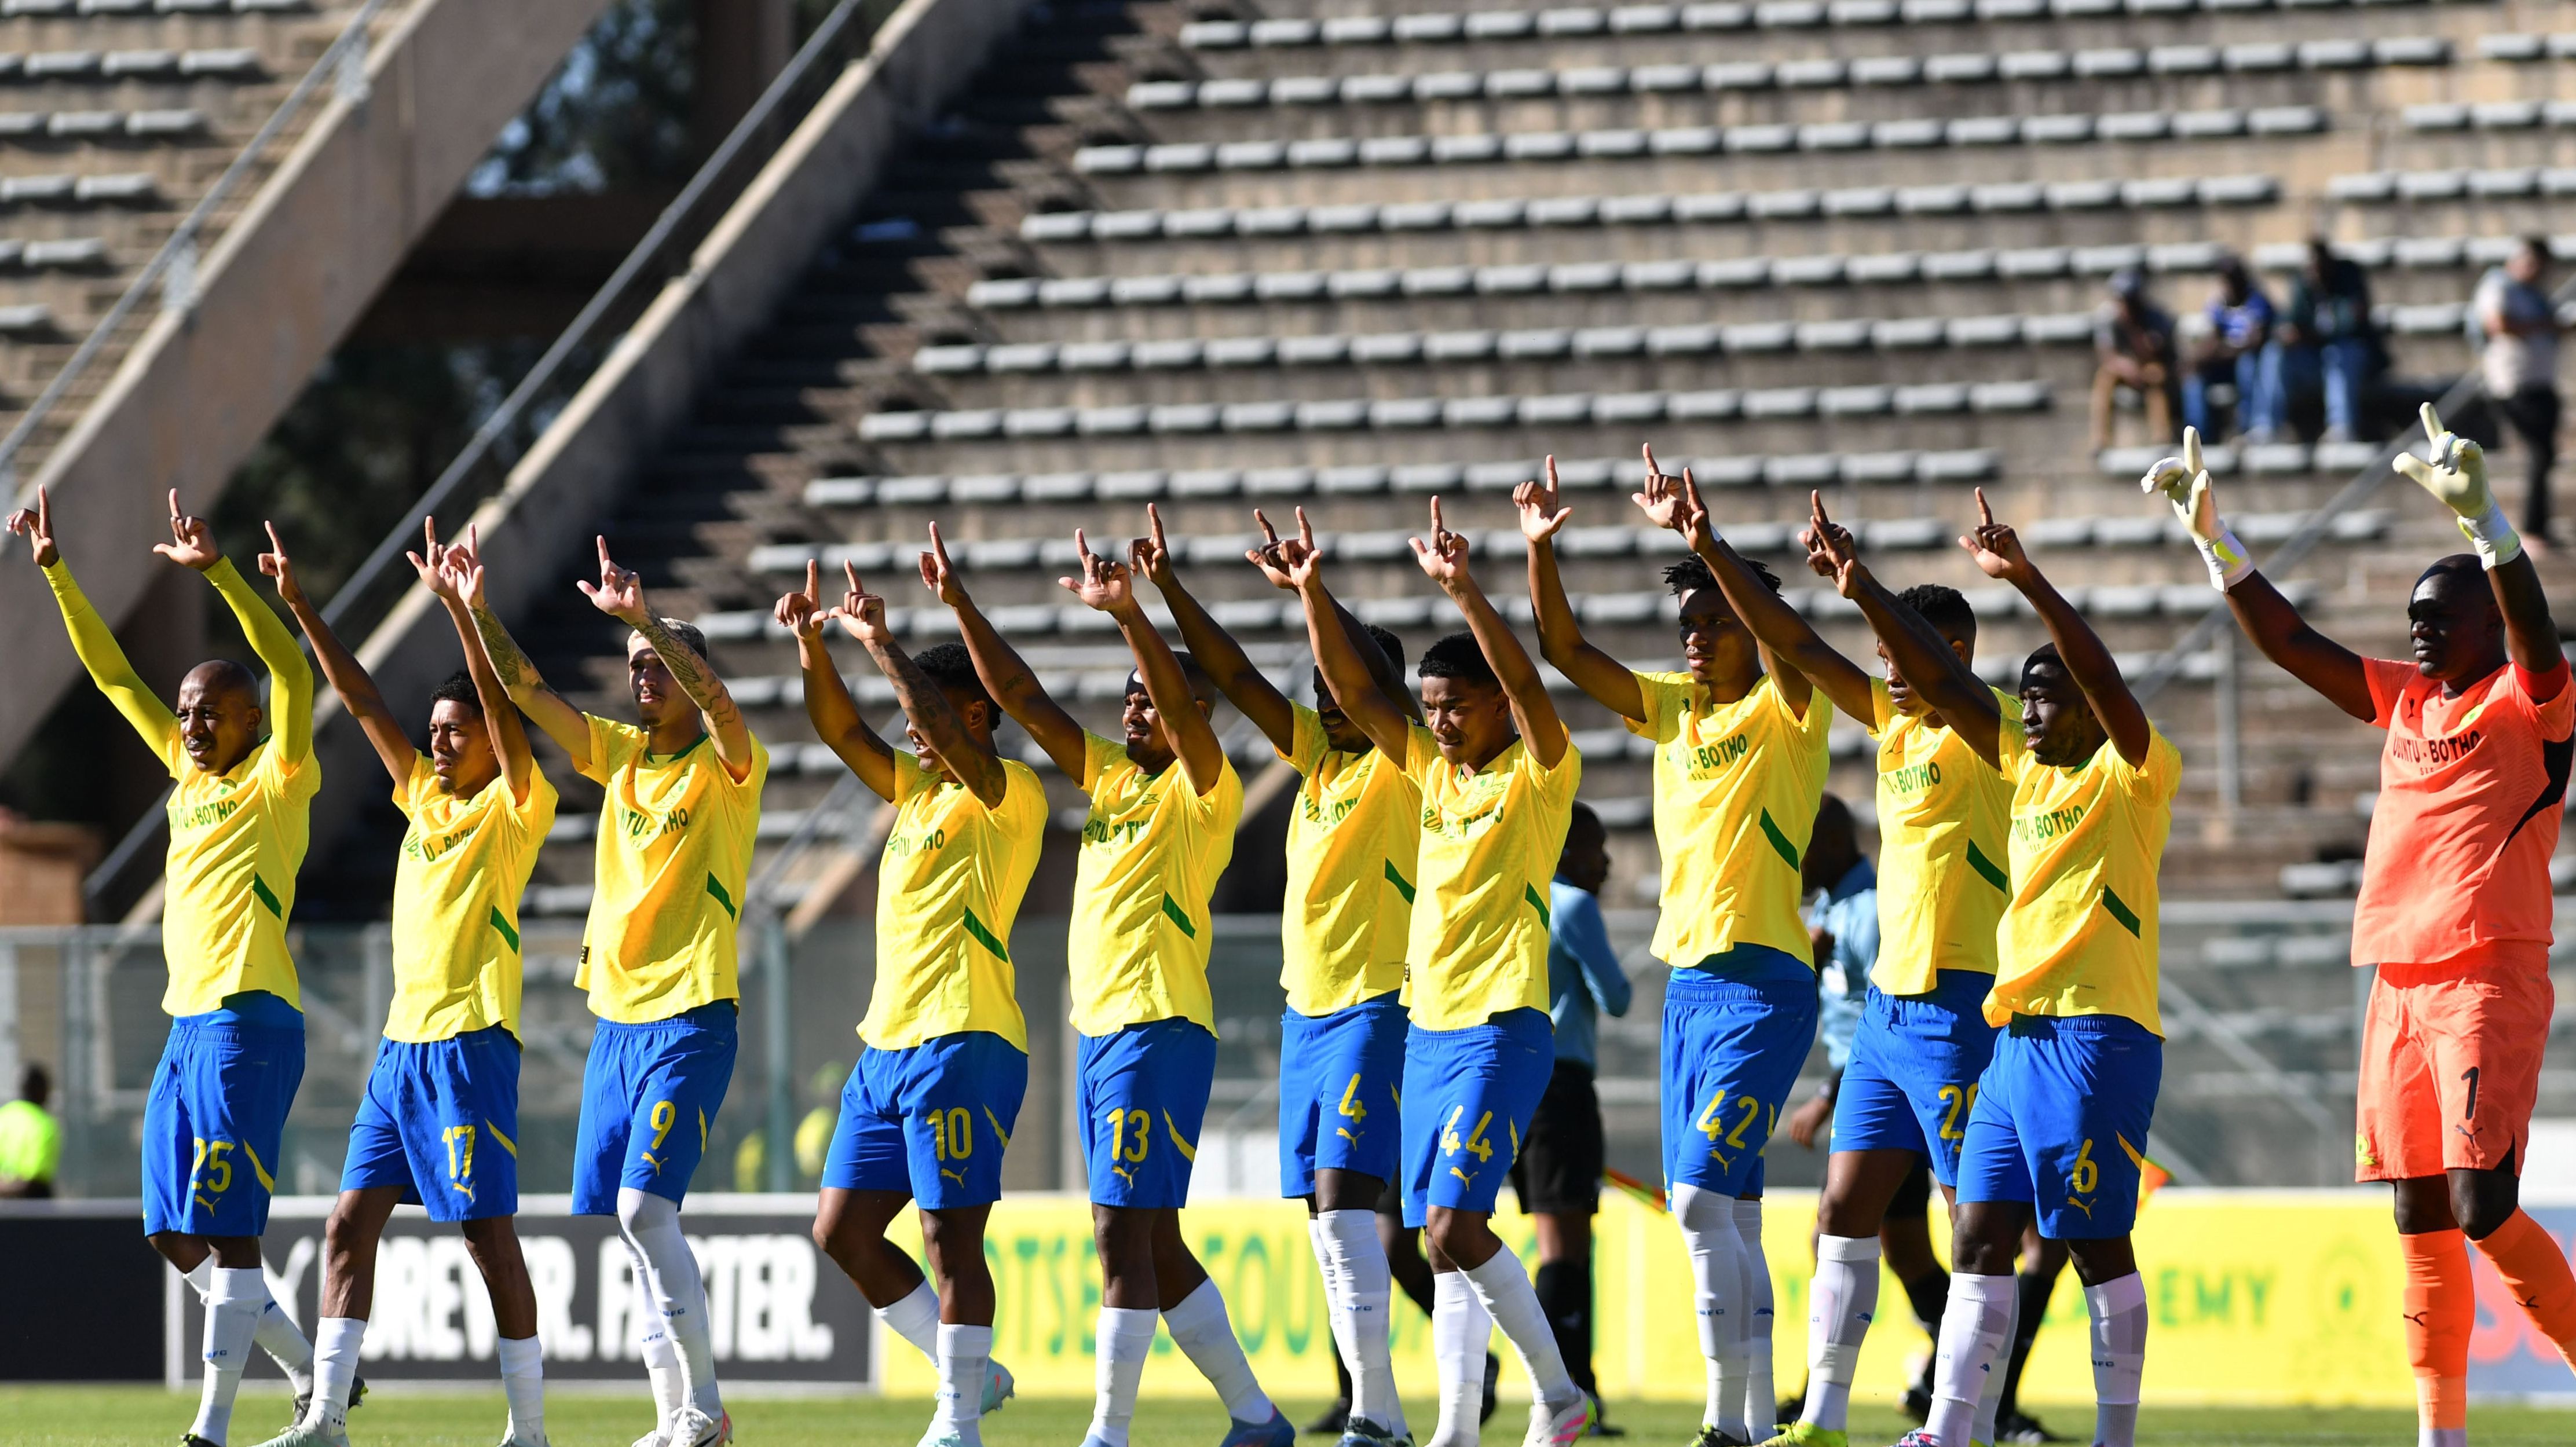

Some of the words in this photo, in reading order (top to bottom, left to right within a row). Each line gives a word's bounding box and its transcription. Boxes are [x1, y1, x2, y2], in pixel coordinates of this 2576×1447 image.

[1698, 734, 1747, 769] BOTHO
[1896, 761, 1941, 793] BOTHO
[1338, 1073, 1367, 1124] 4
[1696, 1089, 1759, 1149] 42
[2461, 1066, 2480, 1120] 1
[441, 1125, 475, 1179] 17
[650, 1100, 676, 1150] 9
[927, 1107, 973, 1162] 10
[1107, 1107, 1151, 1163] 13
[1440, 1104, 1494, 1163] 44
[191, 1137, 236, 1193] 25
[2072, 1138, 2098, 1193] 6
